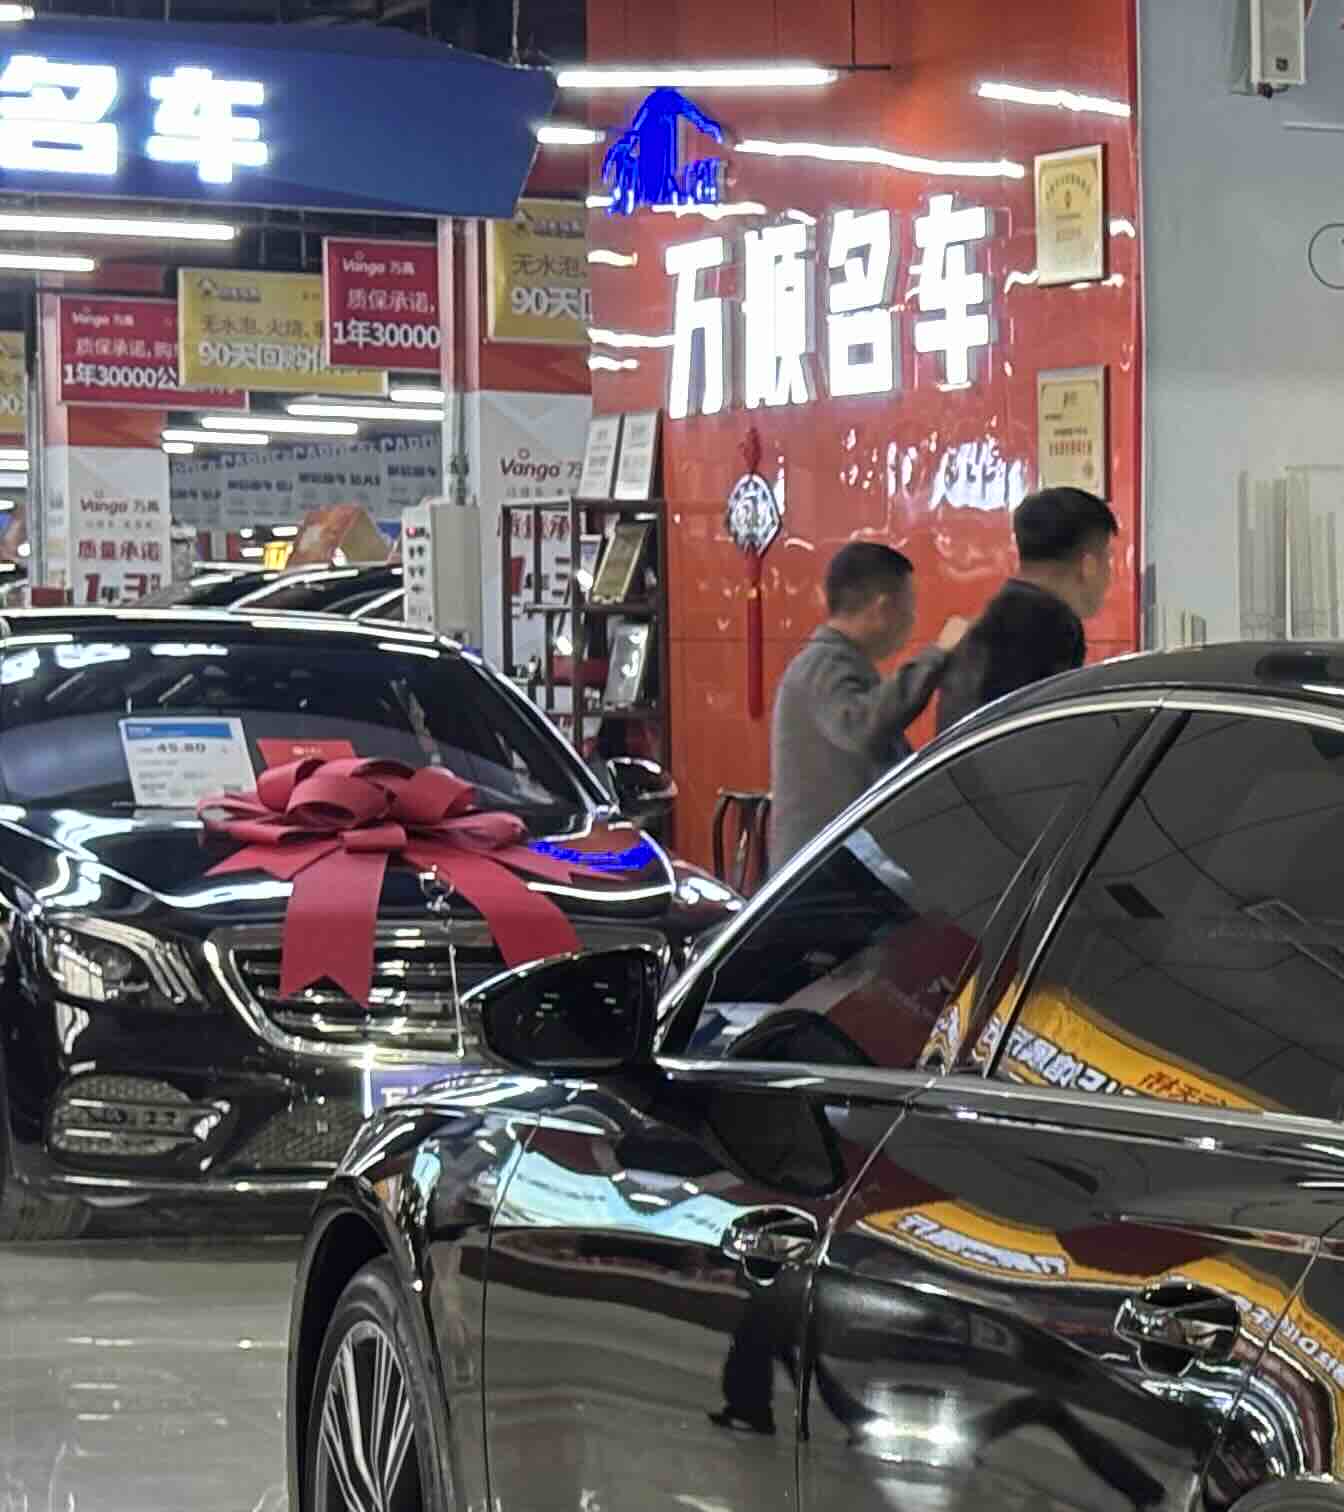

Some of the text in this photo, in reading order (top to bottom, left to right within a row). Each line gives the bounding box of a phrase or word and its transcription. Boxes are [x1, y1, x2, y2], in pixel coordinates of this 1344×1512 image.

[0, 55, 268, 183] 名车
[665, 193, 990, 420] 万顺名车
[500, 457, 561, 481] Vango
